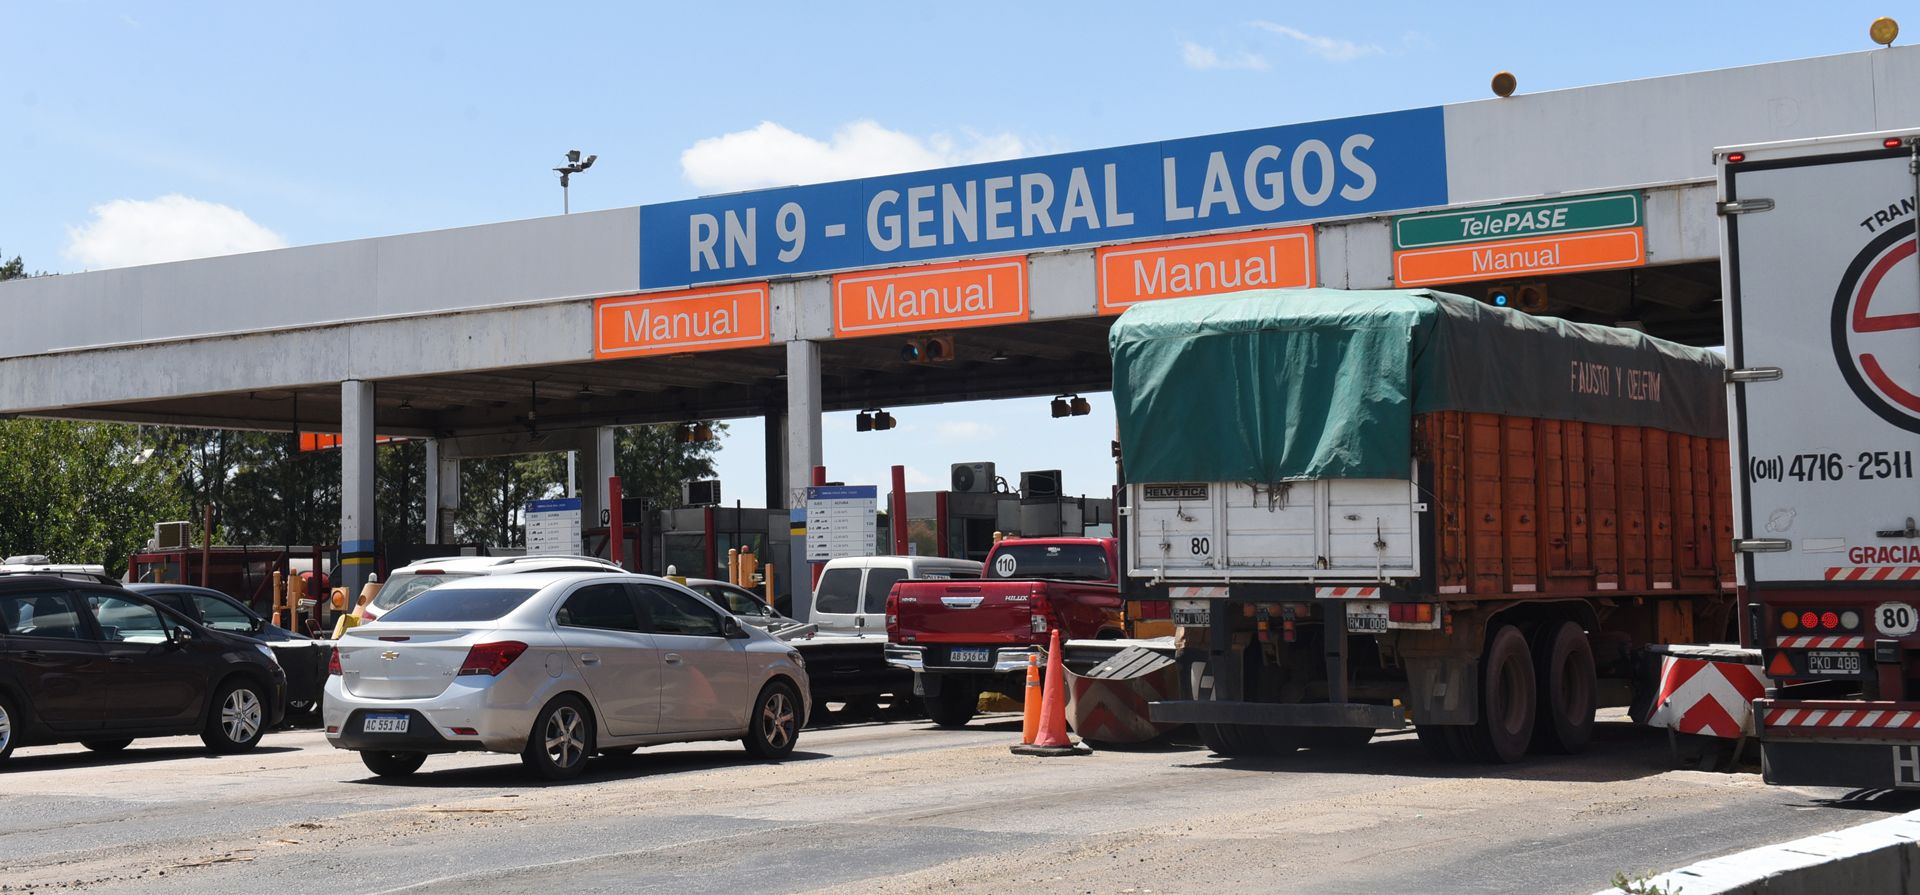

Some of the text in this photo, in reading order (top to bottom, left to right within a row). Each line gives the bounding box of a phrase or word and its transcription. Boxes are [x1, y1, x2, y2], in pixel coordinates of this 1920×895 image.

[689, 206, 757, 272] RN
[777, 202, 805, 262] 9
[866, 162, 1135, 253] GENERAL
[1163, 133, 1378, 222] LAGOS
[1461, 207, 1569, 238] TelePASE
[1472, 243, 1561, 272] Manual
[1133, 246, 1277, 296] Manual
[865, 274, 994, 321] Manual
[624, 300, 739, 343] Manual
[1571, 360, 1609, 396] FAUSTO
[1615, 366, 1622, 398] Y
[1750, 455, 1784, 483] (011)
[1144, 487, 1207, 497] HELVETICA
[1191, 537, 1210, 555] 80
[998, 558, 1014, 572] 110
[1175, 613, 1191, 624] RWJ
[1350, 617, 1386, 630] RWJ 008
[1882, 607, 1910, 629] 80
[951, 652, 962, 661] AB
[978, 652, 988, 662] CK
[1810, 657, 1859, 670] PKO 488
[365, 720, 376, 731] AC
[378, 720, 394, 731] 551
